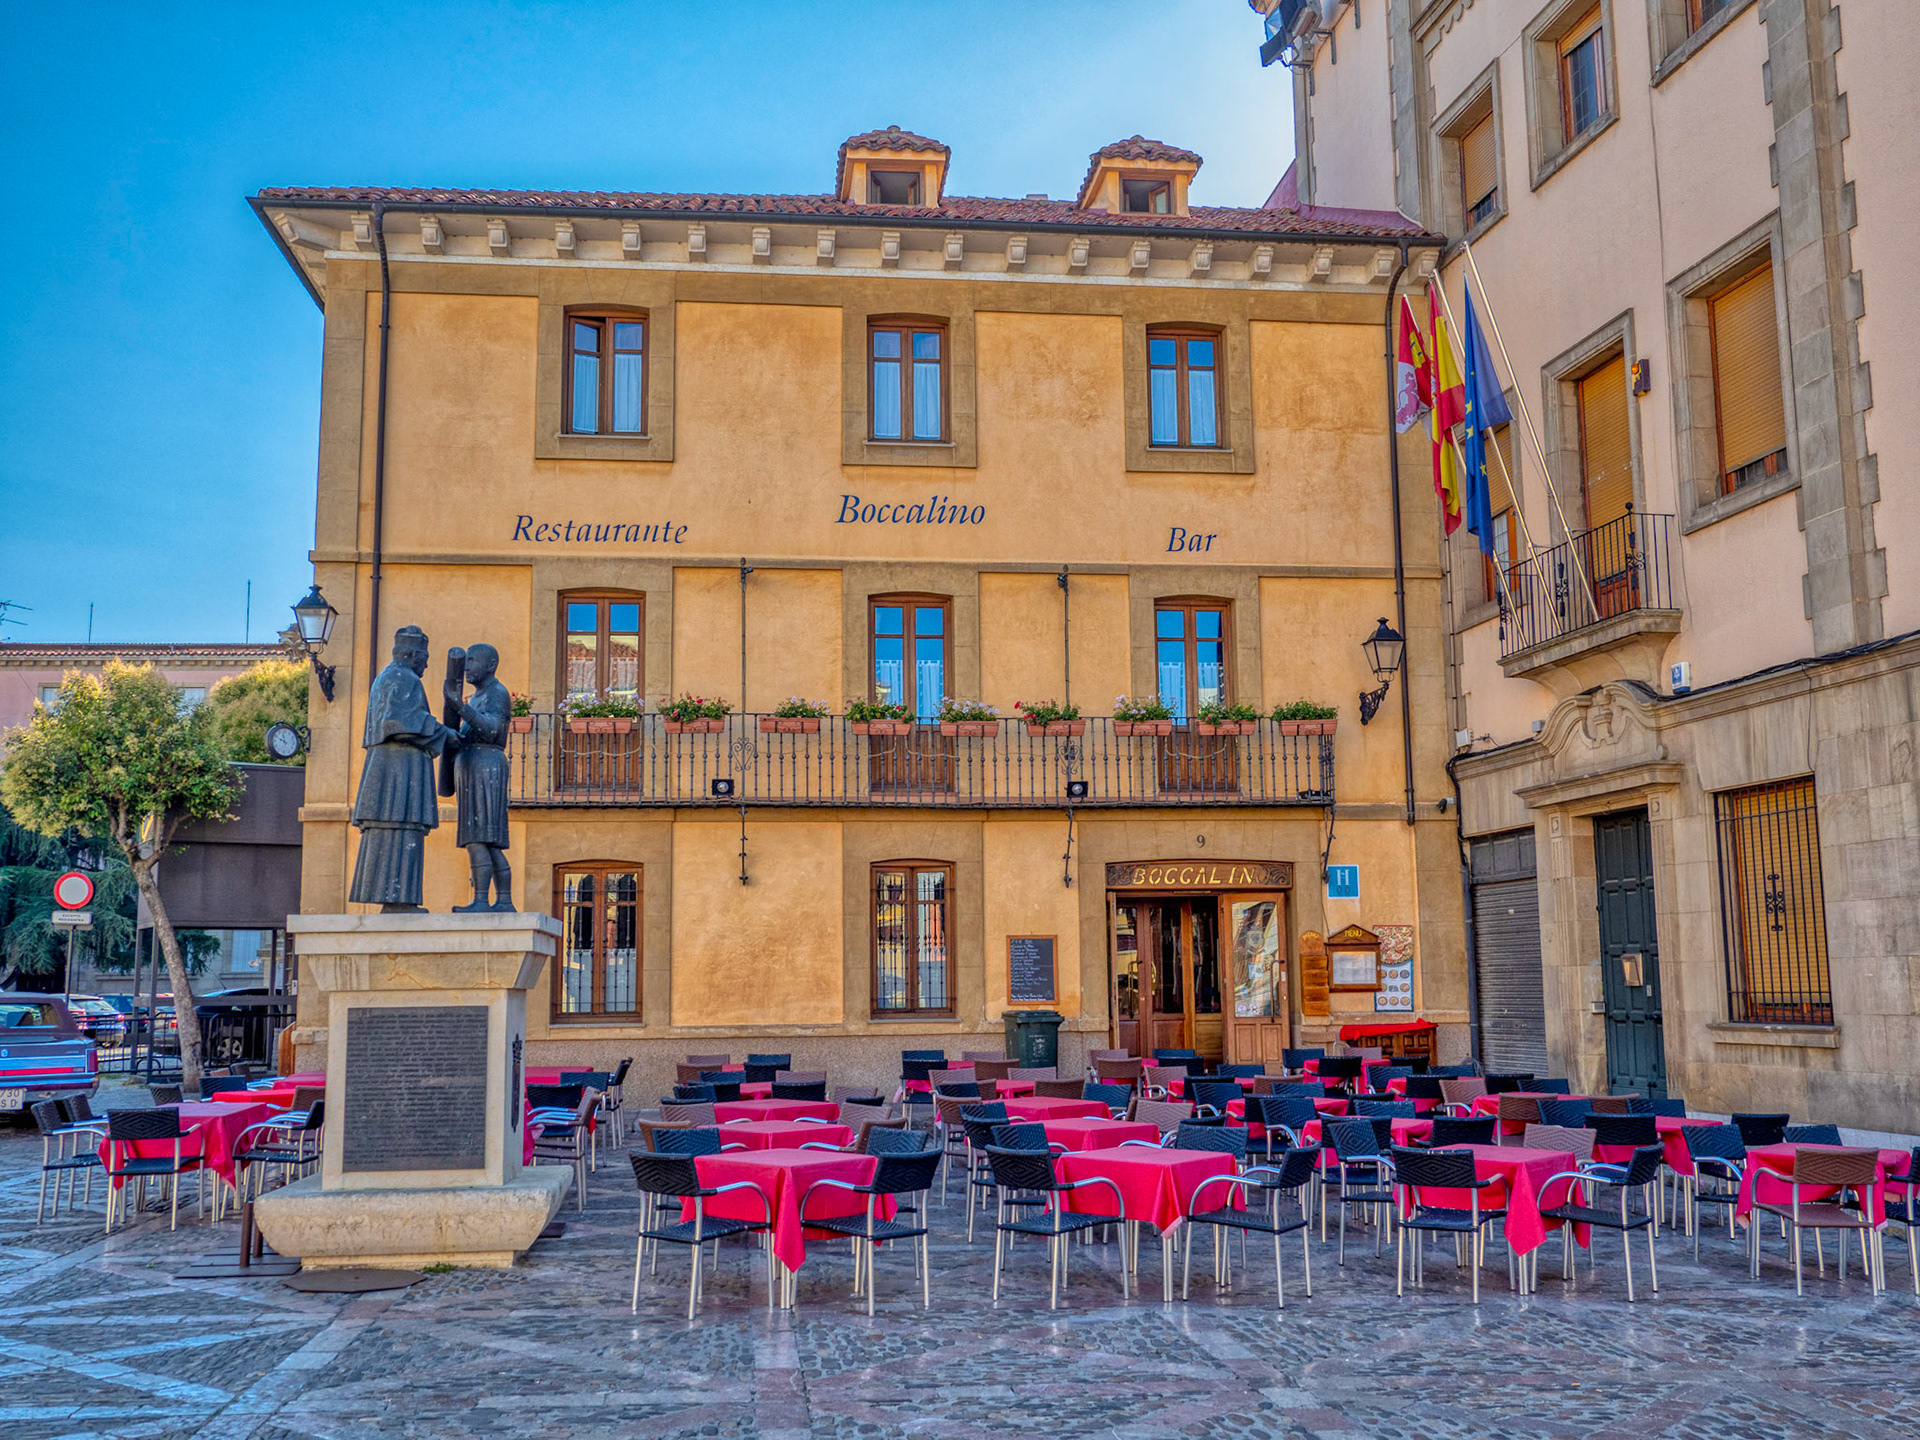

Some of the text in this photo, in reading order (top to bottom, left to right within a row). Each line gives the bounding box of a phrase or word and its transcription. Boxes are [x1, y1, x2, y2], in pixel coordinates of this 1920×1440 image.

[833, 494, 986, 525] Boccalino
[511, 514, 688, 544] Restaurante
[1165, 527, 1218, 552] Bar
[1196, 834, 1206, 848] 9
[1132, 866, 1270, 885] BOCCALINO
[1344, 929, 1363, 938] MENU
